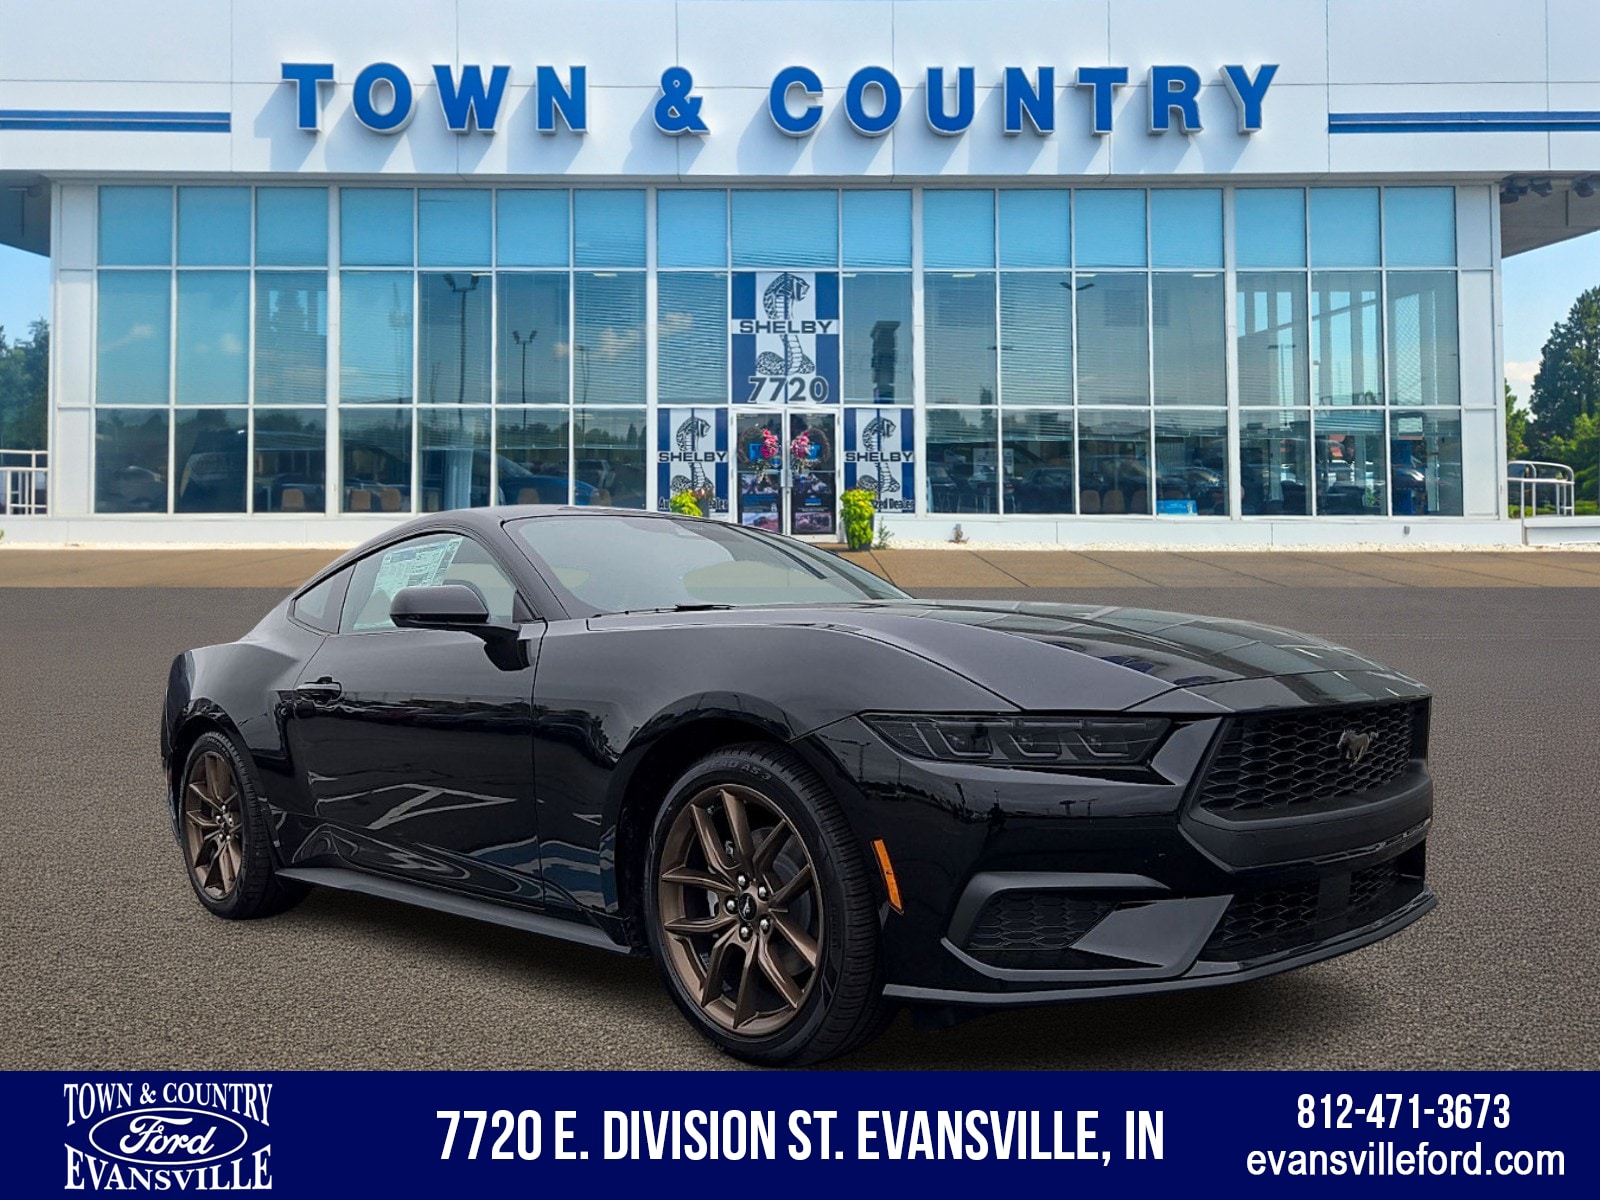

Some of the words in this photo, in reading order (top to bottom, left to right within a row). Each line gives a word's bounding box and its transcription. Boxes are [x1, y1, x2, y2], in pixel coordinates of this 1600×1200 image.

[281, 62, 589, 134] TOWN
[653, 66, 710, 135] &
[769, 64, 1279, 136] COUNTRY
[739, 320, 833, 335] SHELBY
[748, 376, 829, 403] 7720
[658, 451, 727, 462] SHELBY
[845, 451, 914, 462] SHELBY
